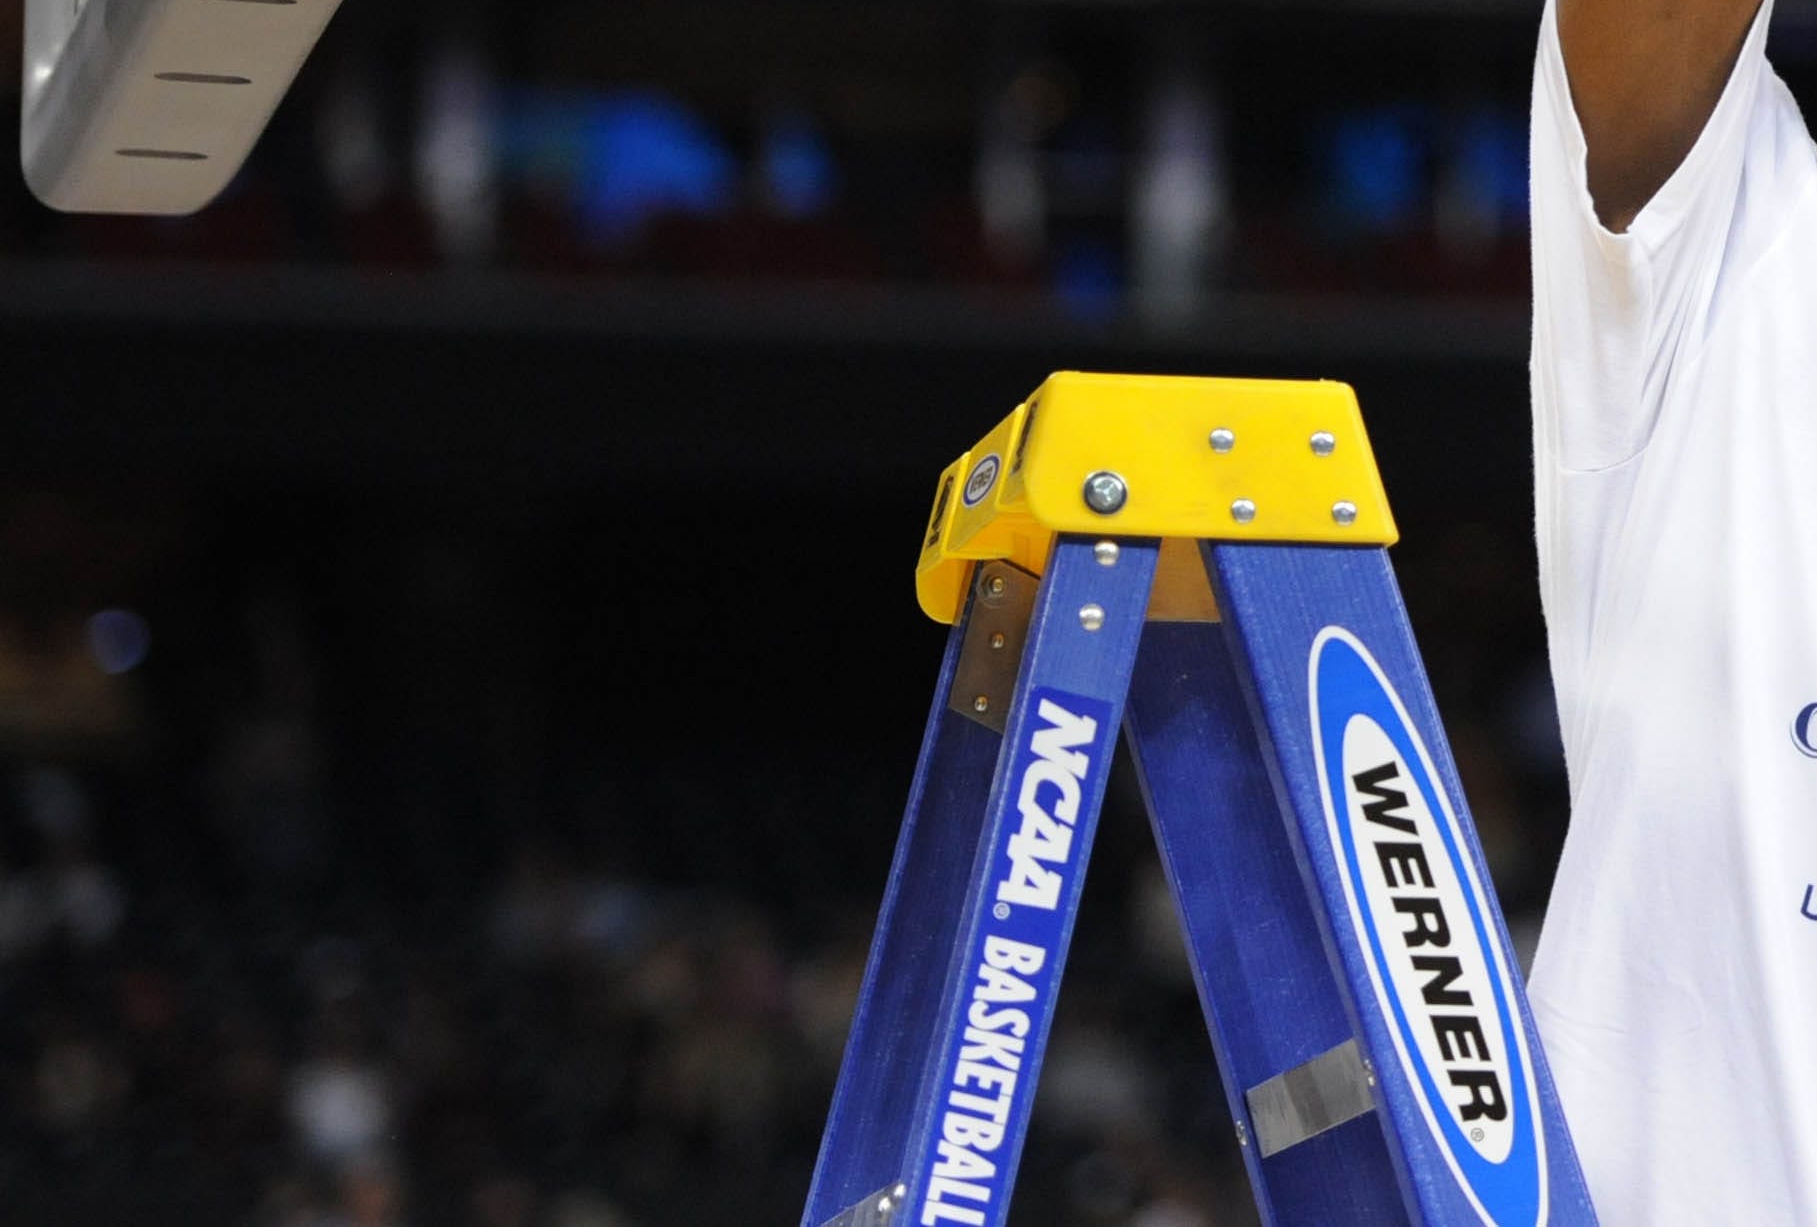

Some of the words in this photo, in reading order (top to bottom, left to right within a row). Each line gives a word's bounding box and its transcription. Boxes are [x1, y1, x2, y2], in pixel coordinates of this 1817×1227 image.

[996, 698, 1097, 911] NCAA
[1352, 761, 1508, 1122] WERNER
[921, 934, 1046, 1227] BASKETBALL
